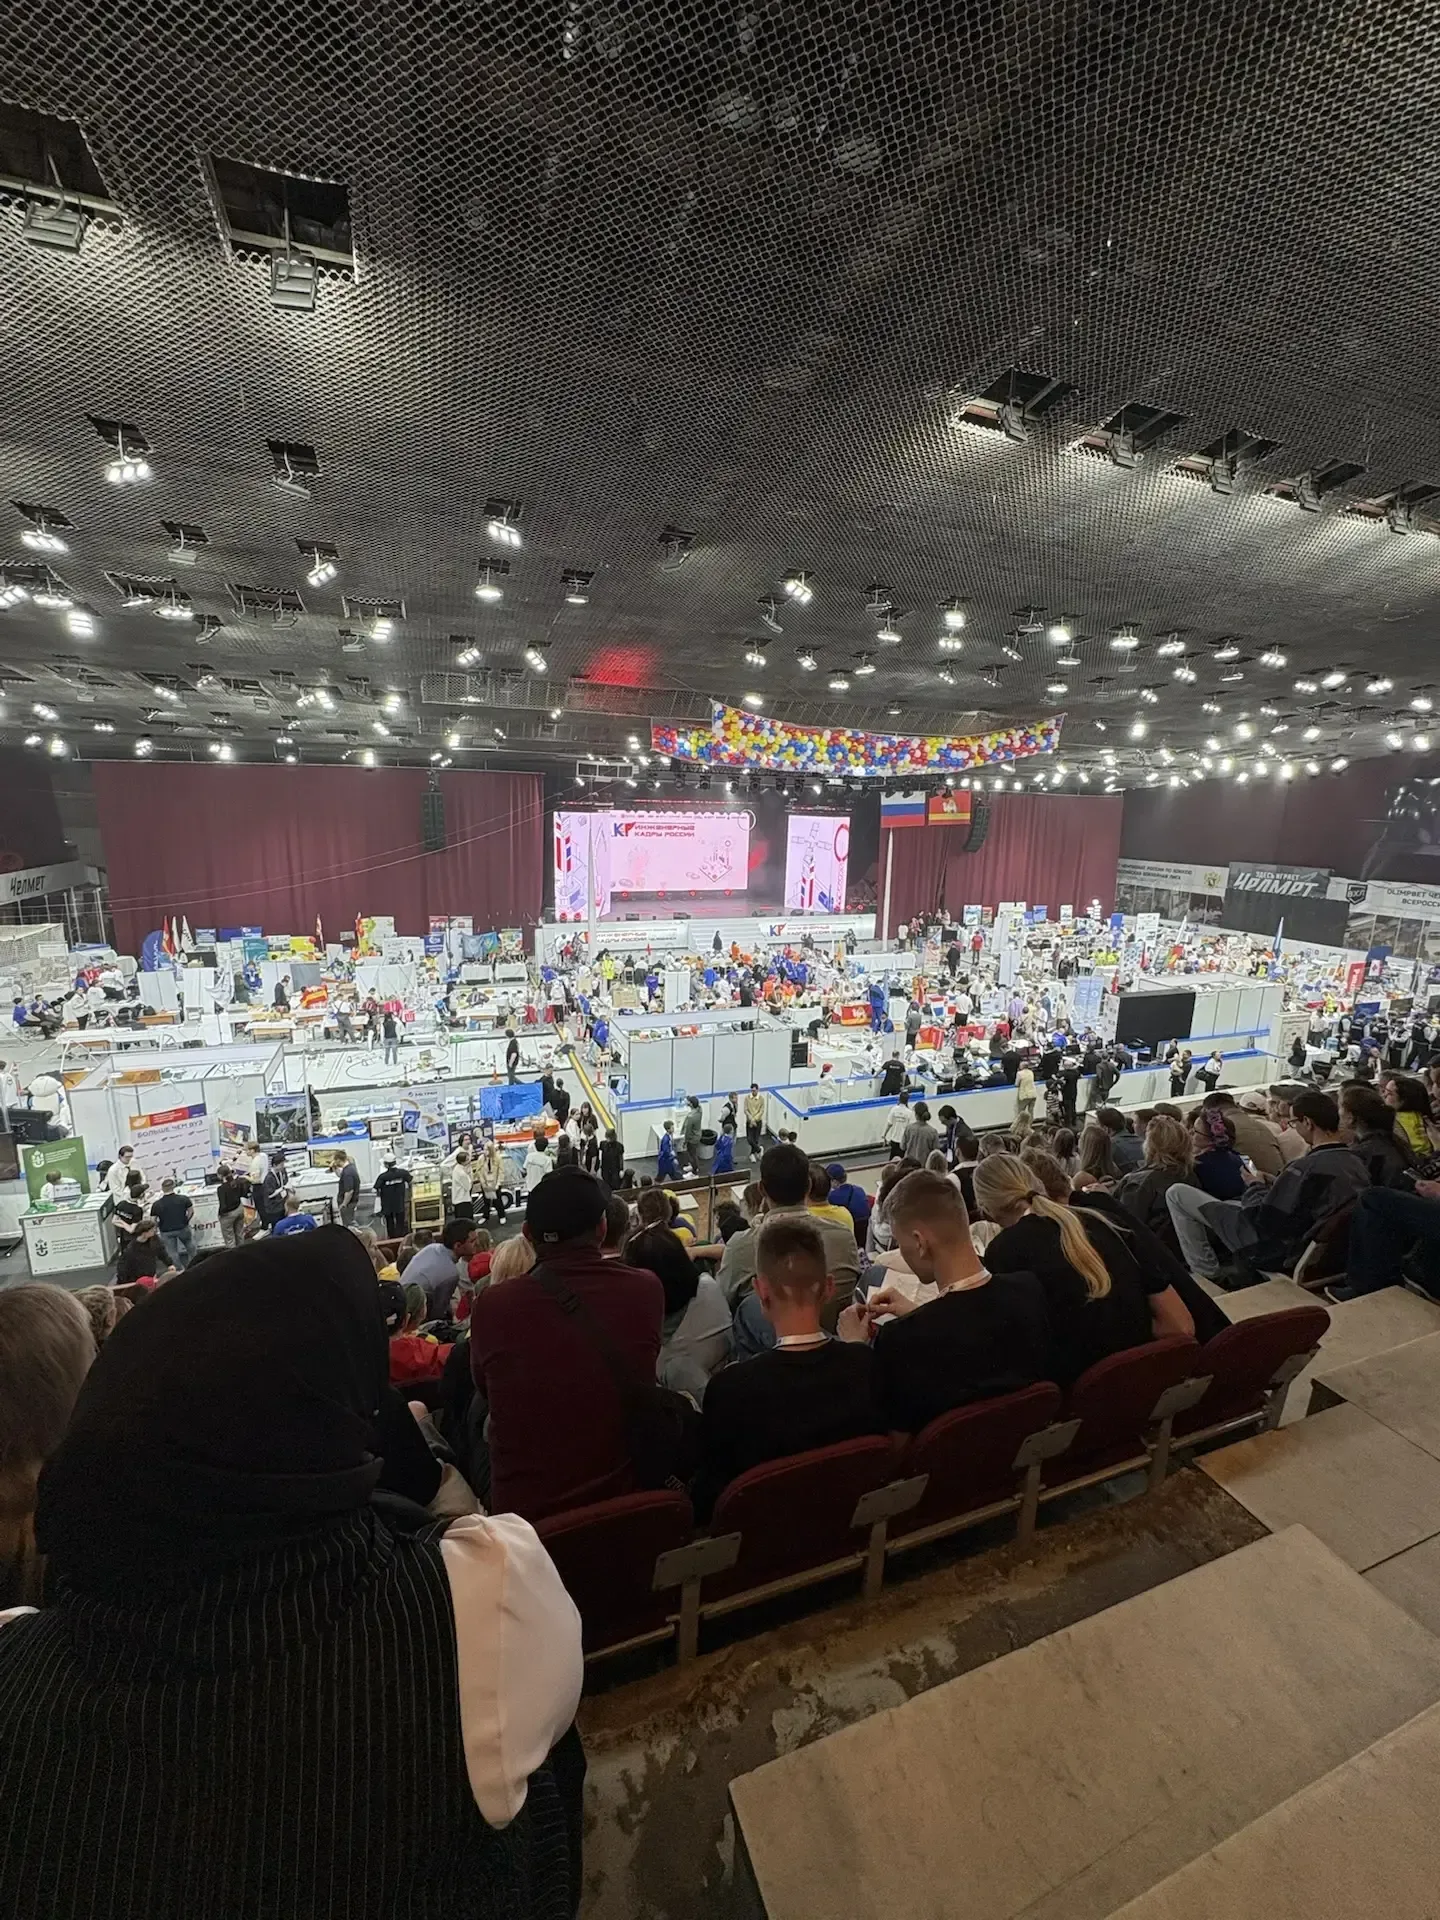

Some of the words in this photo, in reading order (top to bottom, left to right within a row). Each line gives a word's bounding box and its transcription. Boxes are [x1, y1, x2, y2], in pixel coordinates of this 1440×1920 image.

[1255, 871, 1275, 879] ЗДЕСЬ
[1275, 872, 1300, 880] ИГРАЕТ
[1347, 889, 1366, 898] ВХЛ
[1387, 888, 1426, 898] OLIMPBET
[1428, 891, 1440, 899] ЧЕ
[137, 1126, 170, 1139] БОЛЬШЕ
[172, 1123, 188, 1131] ЧЕМ
[189, 1120, 203, 1128] ВУЗ
